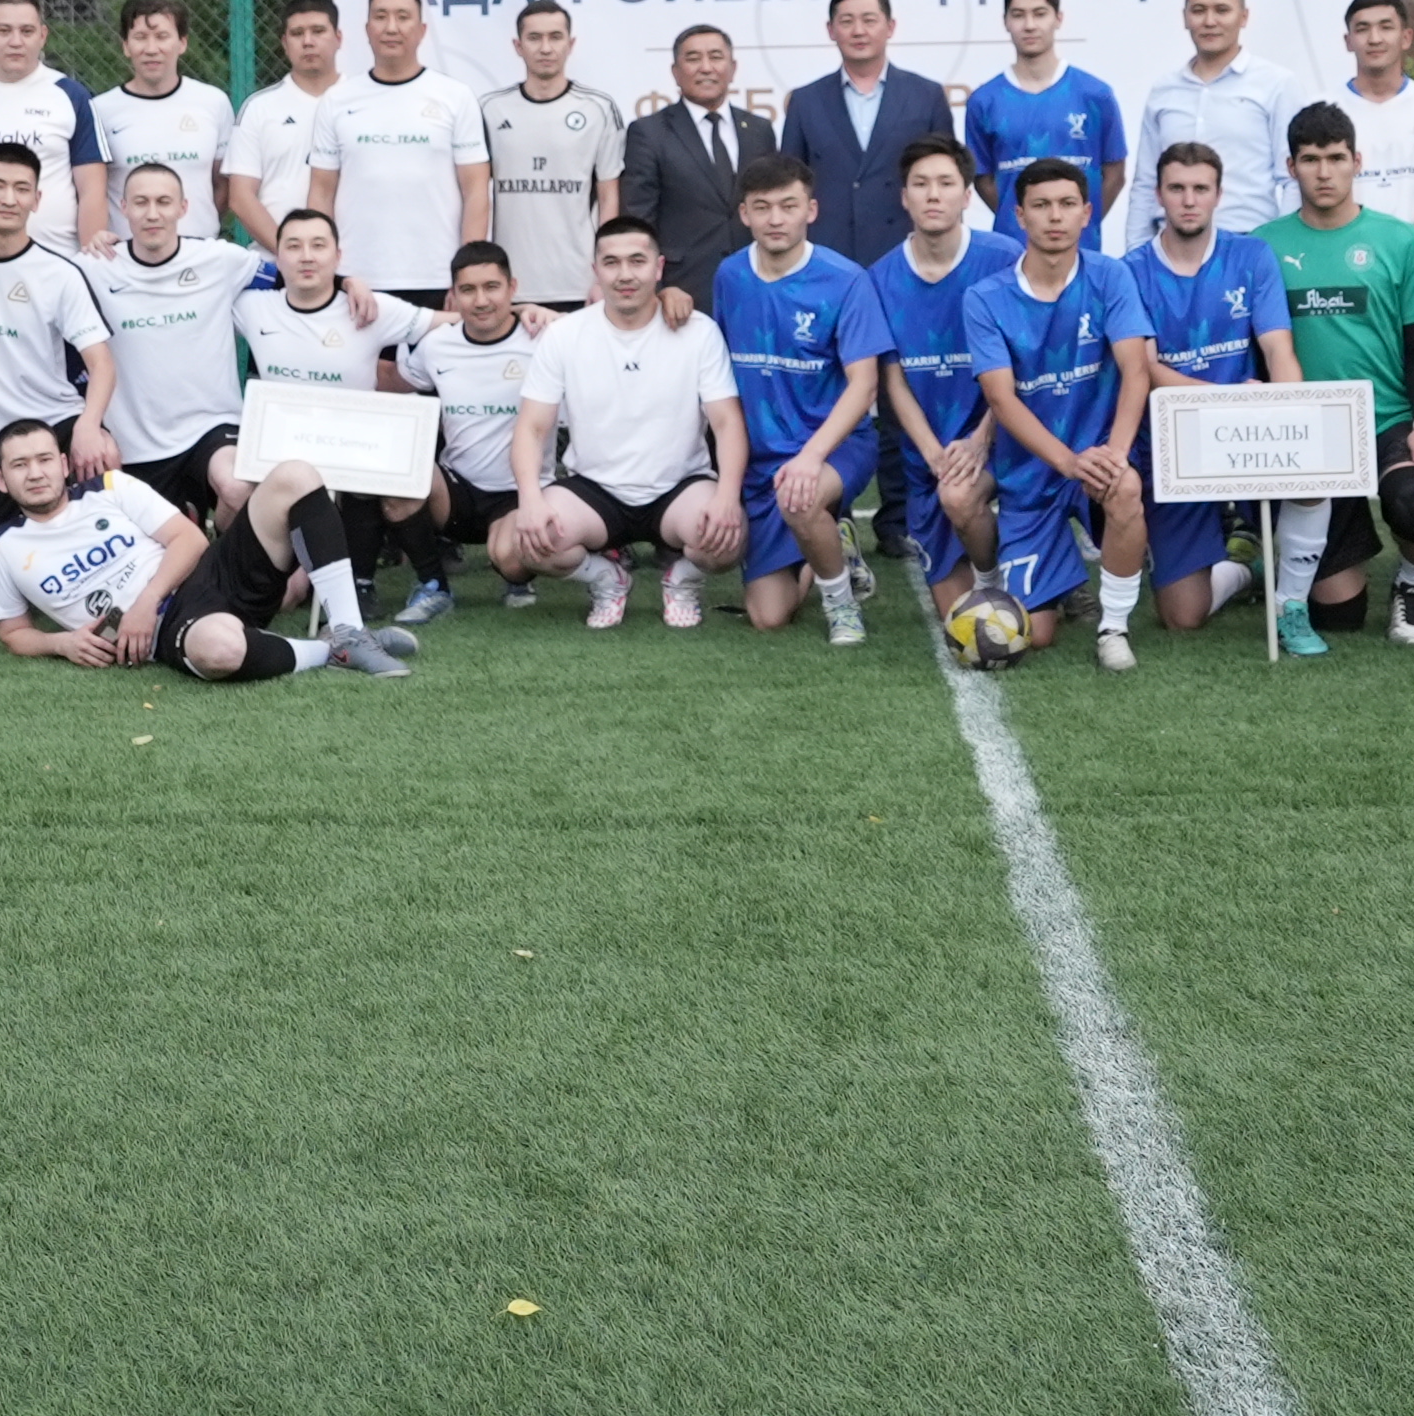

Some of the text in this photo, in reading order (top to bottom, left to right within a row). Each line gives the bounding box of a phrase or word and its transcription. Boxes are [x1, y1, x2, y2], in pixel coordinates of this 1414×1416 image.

[532, 156, 547, 171] IP
[498, 179, 583, 194] KAIRALAPOV
[121, 310, 198, 330] #BCC_TEAM
[1157, 338, 1251, 363] AKARIM UNIVERS
[899, 354, 941, 367] AKARIM
[267, 364, 343, 383] #BCC_TEAM
[444, 404, 519, 417] #BCC_TEAM
[1214, 424, 1309, 443] САНАЛЫ
[1227, 451, 1301, 470] ҰРПАҚ
[61, 533, 135, 583] slon
